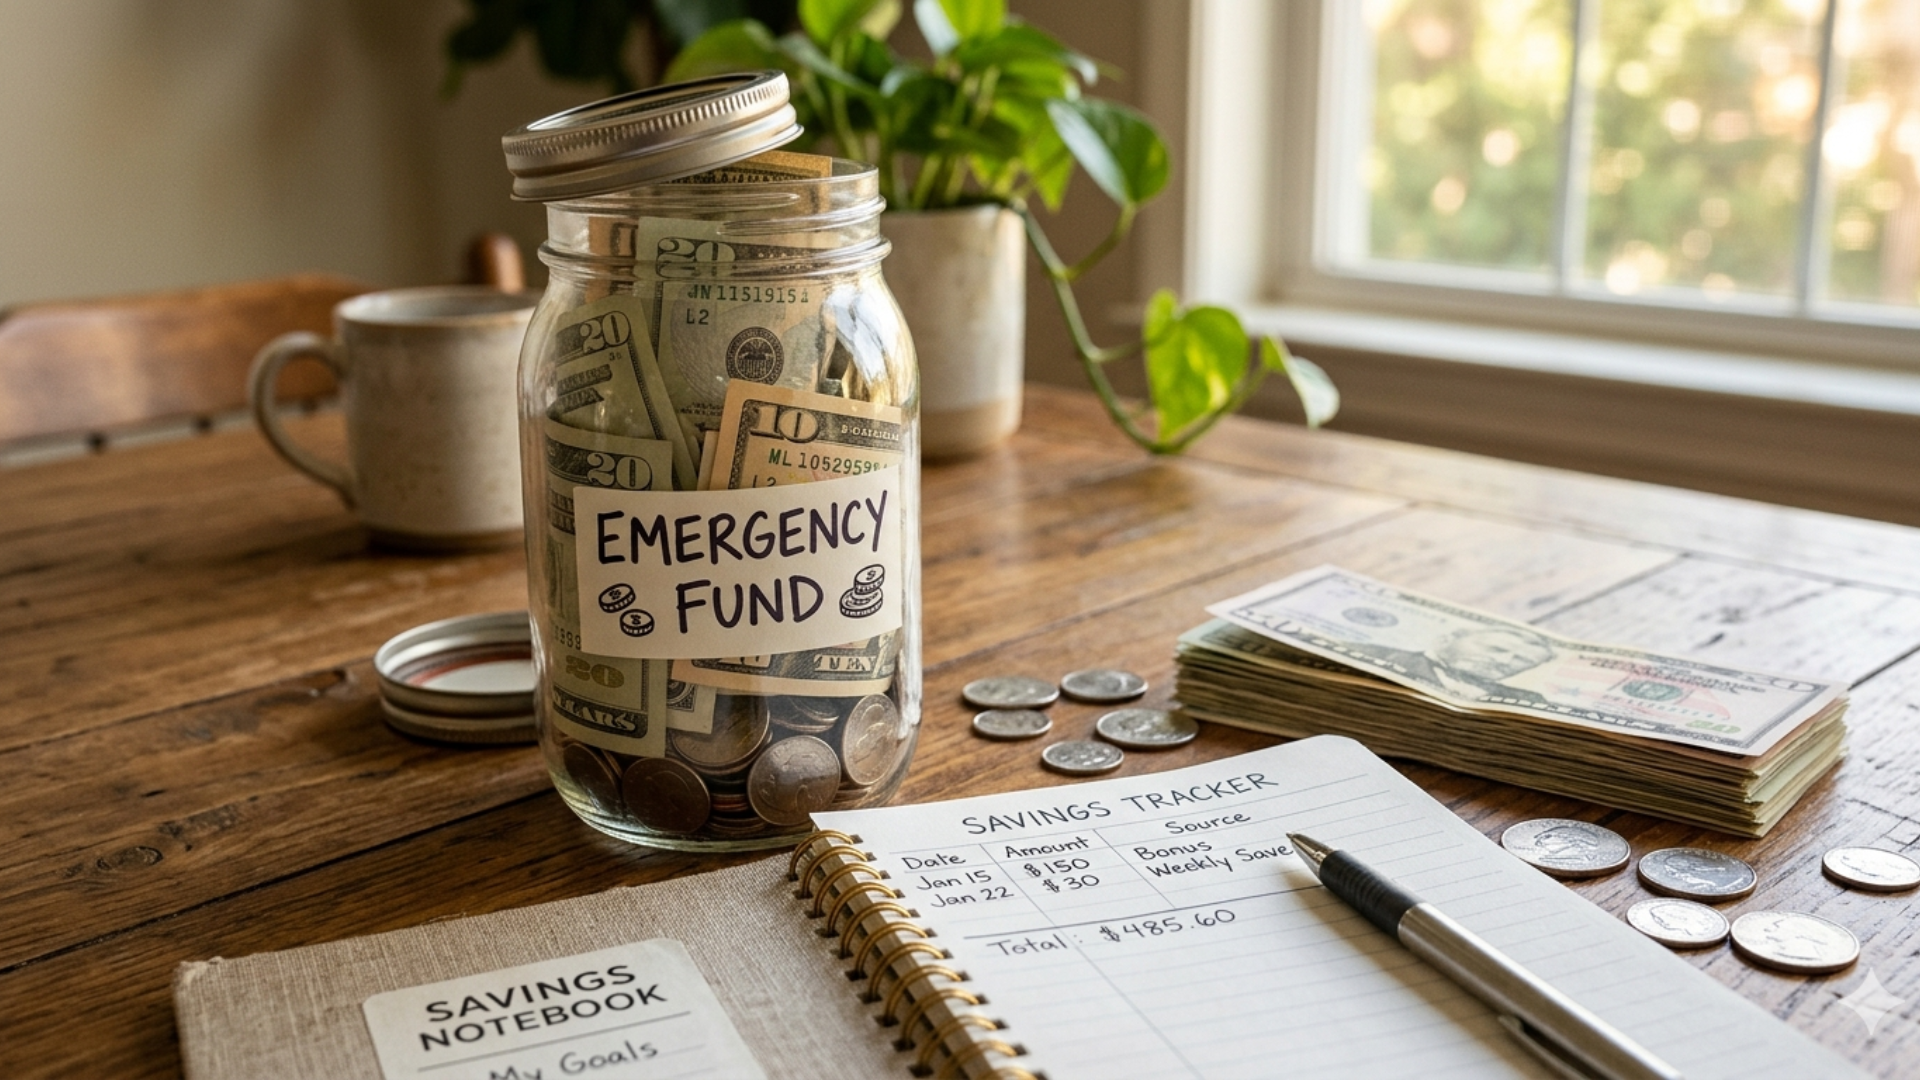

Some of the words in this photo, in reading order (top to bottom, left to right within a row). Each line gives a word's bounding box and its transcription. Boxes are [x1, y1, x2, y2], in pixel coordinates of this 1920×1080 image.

[579, 311, 631, 352] 20
[687, 308, 709, 325] L2
[750, 404, 819, 443] 10
[587, 452, 652, 490] 20
[768, 448, 792, 467] ML
[597, 490, 888, 566] EMERGENCY
[676, 575, 824, 633] FUND
[962, 801, 1111, 834] SAVINGS
[1120, 773, 1279, 812] TRACKER
[901, 853, 966, 870] Date
[1005, 836, 1089, 858] Amount
[1165, 813, 1251, 834] Source
[916, 876, 962, 890] Jan
[965, 870, 992, 884] 15
[1133, 841, 1212, 861] Bonus
[931, 893, 976, 908] Jan
[980, 886, 1014, 900] 22
[1146, 855, 1233, 878] Weekly
[1235, 845, 1294, 862] Save
[1099, 909, 1236, 942] $485.60
[419, 984, 668, 1051] NOTEBOOK
[426, 965, 636, 1022] SAVINGS
[560, 1040, 658, 1075] Goals
